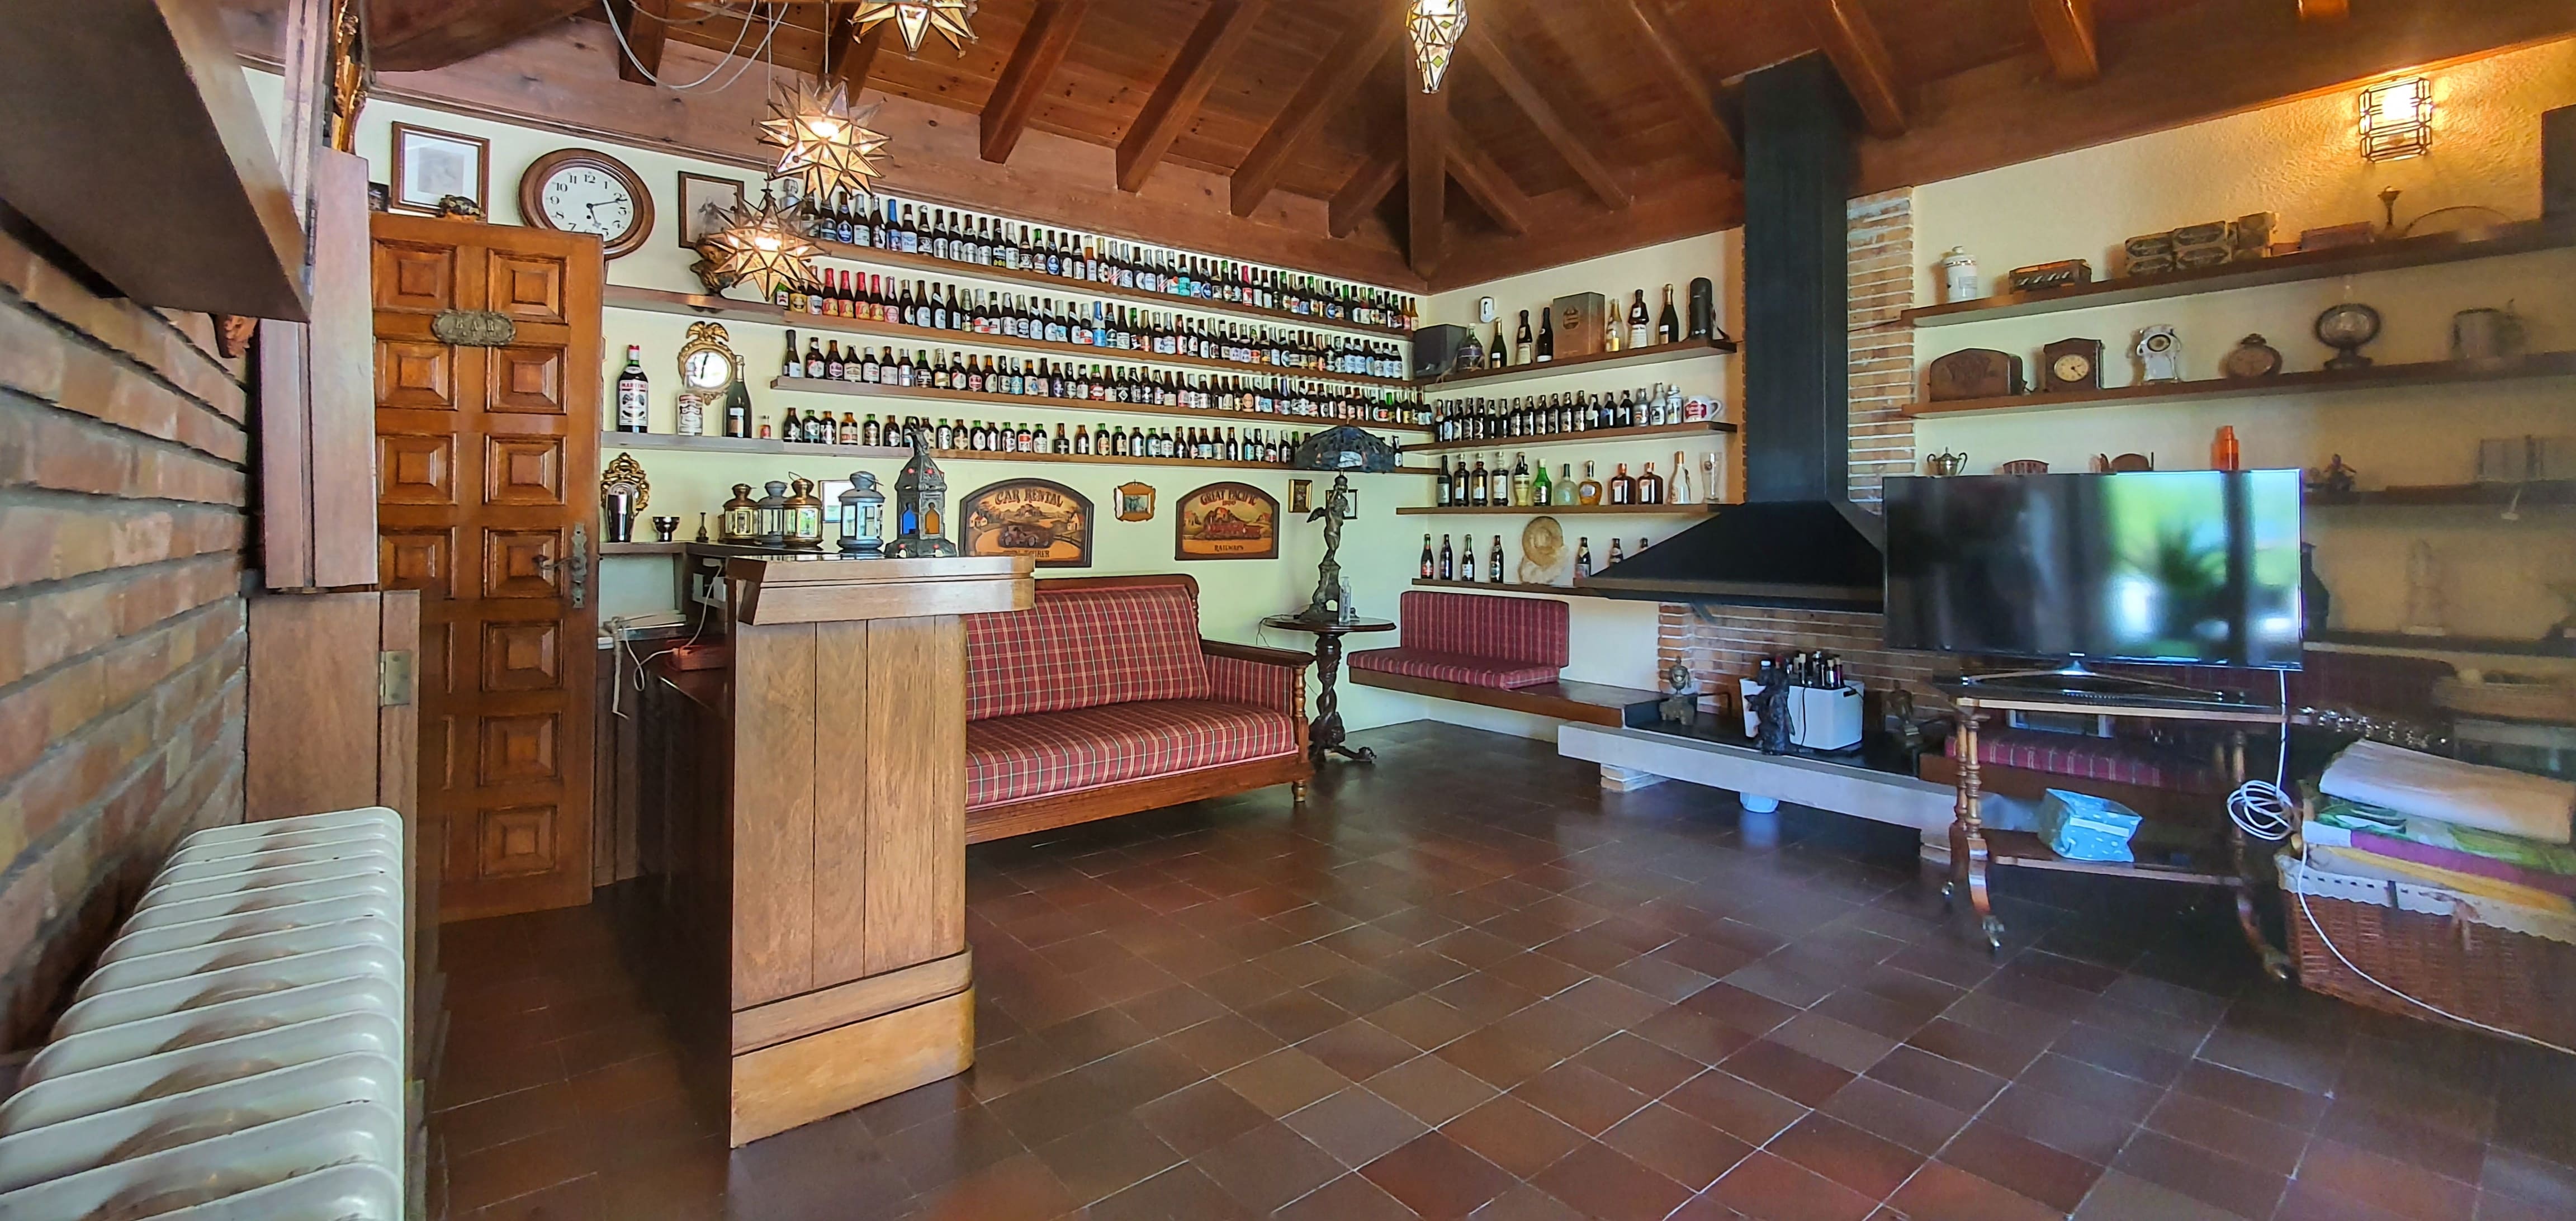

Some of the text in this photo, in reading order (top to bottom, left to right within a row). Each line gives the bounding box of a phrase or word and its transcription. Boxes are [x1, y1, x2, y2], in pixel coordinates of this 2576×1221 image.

[569, 174, 577, 184] 11
[584, 174, 596, 184] 12
[556, 182, 568, 192] 10
[604, 181, 608, 190] 1
[550, 196, 560, 205] 9
[555, 211, 565, 220] 8
[618, 206, 627, 216] 3
[568, 223, 577, 231] 7
[612, 220, 621, 229] 4
[602, 228, 609, 237] 5
[455, 318, 495, 332] BAR
[995, 488, 1063, 508] CAR RENTAL
[1200, 490, 1257, 506] GREAT PACIFIC
